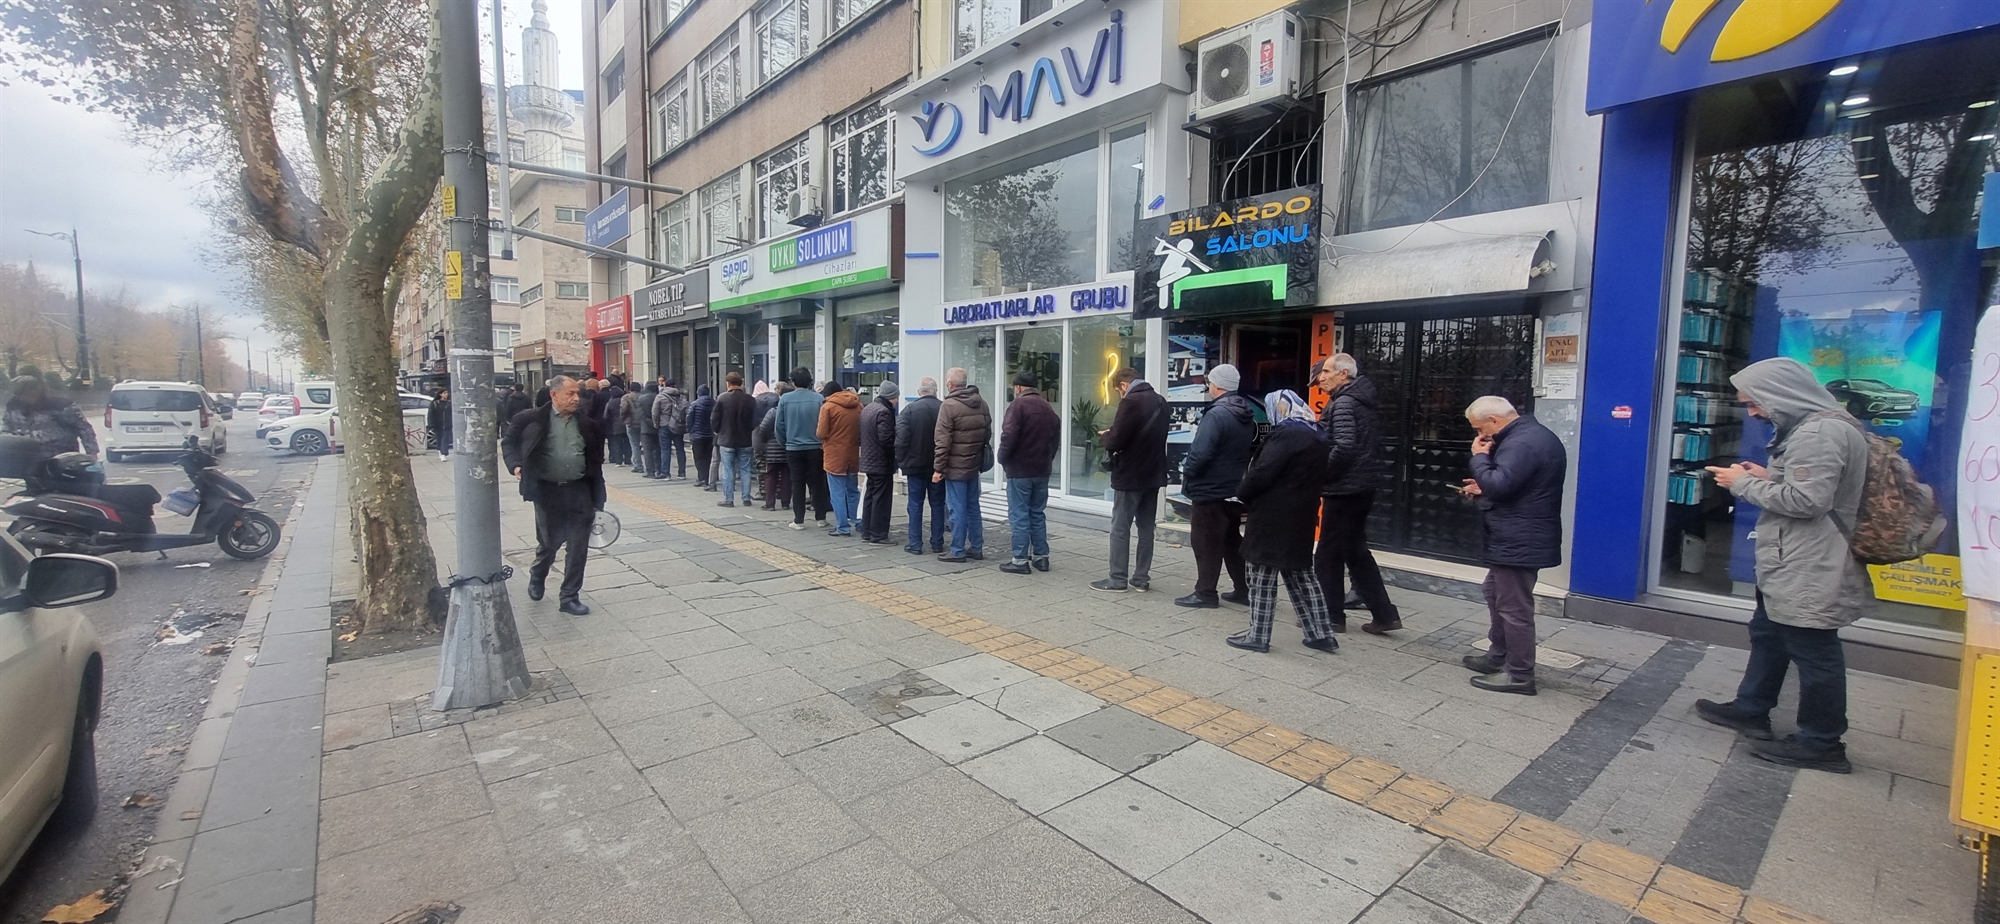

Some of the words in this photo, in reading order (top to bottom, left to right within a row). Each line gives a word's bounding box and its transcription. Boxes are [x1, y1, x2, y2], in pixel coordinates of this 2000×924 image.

[1168, 196, 1312, 236] BİLARDO
[772, 242, 795, 269] UYKU
[798, 227, 848, 262] SOLUNUM
[1206, 223, 1309, 256] SALONU
[648, 286, 670, 306] NOBEL
[671, 283, 684, 301] TIP
[943, 294, 1055, 325] LABORATUARLAR
[1070, 285, 1128, 312] GRUBU
